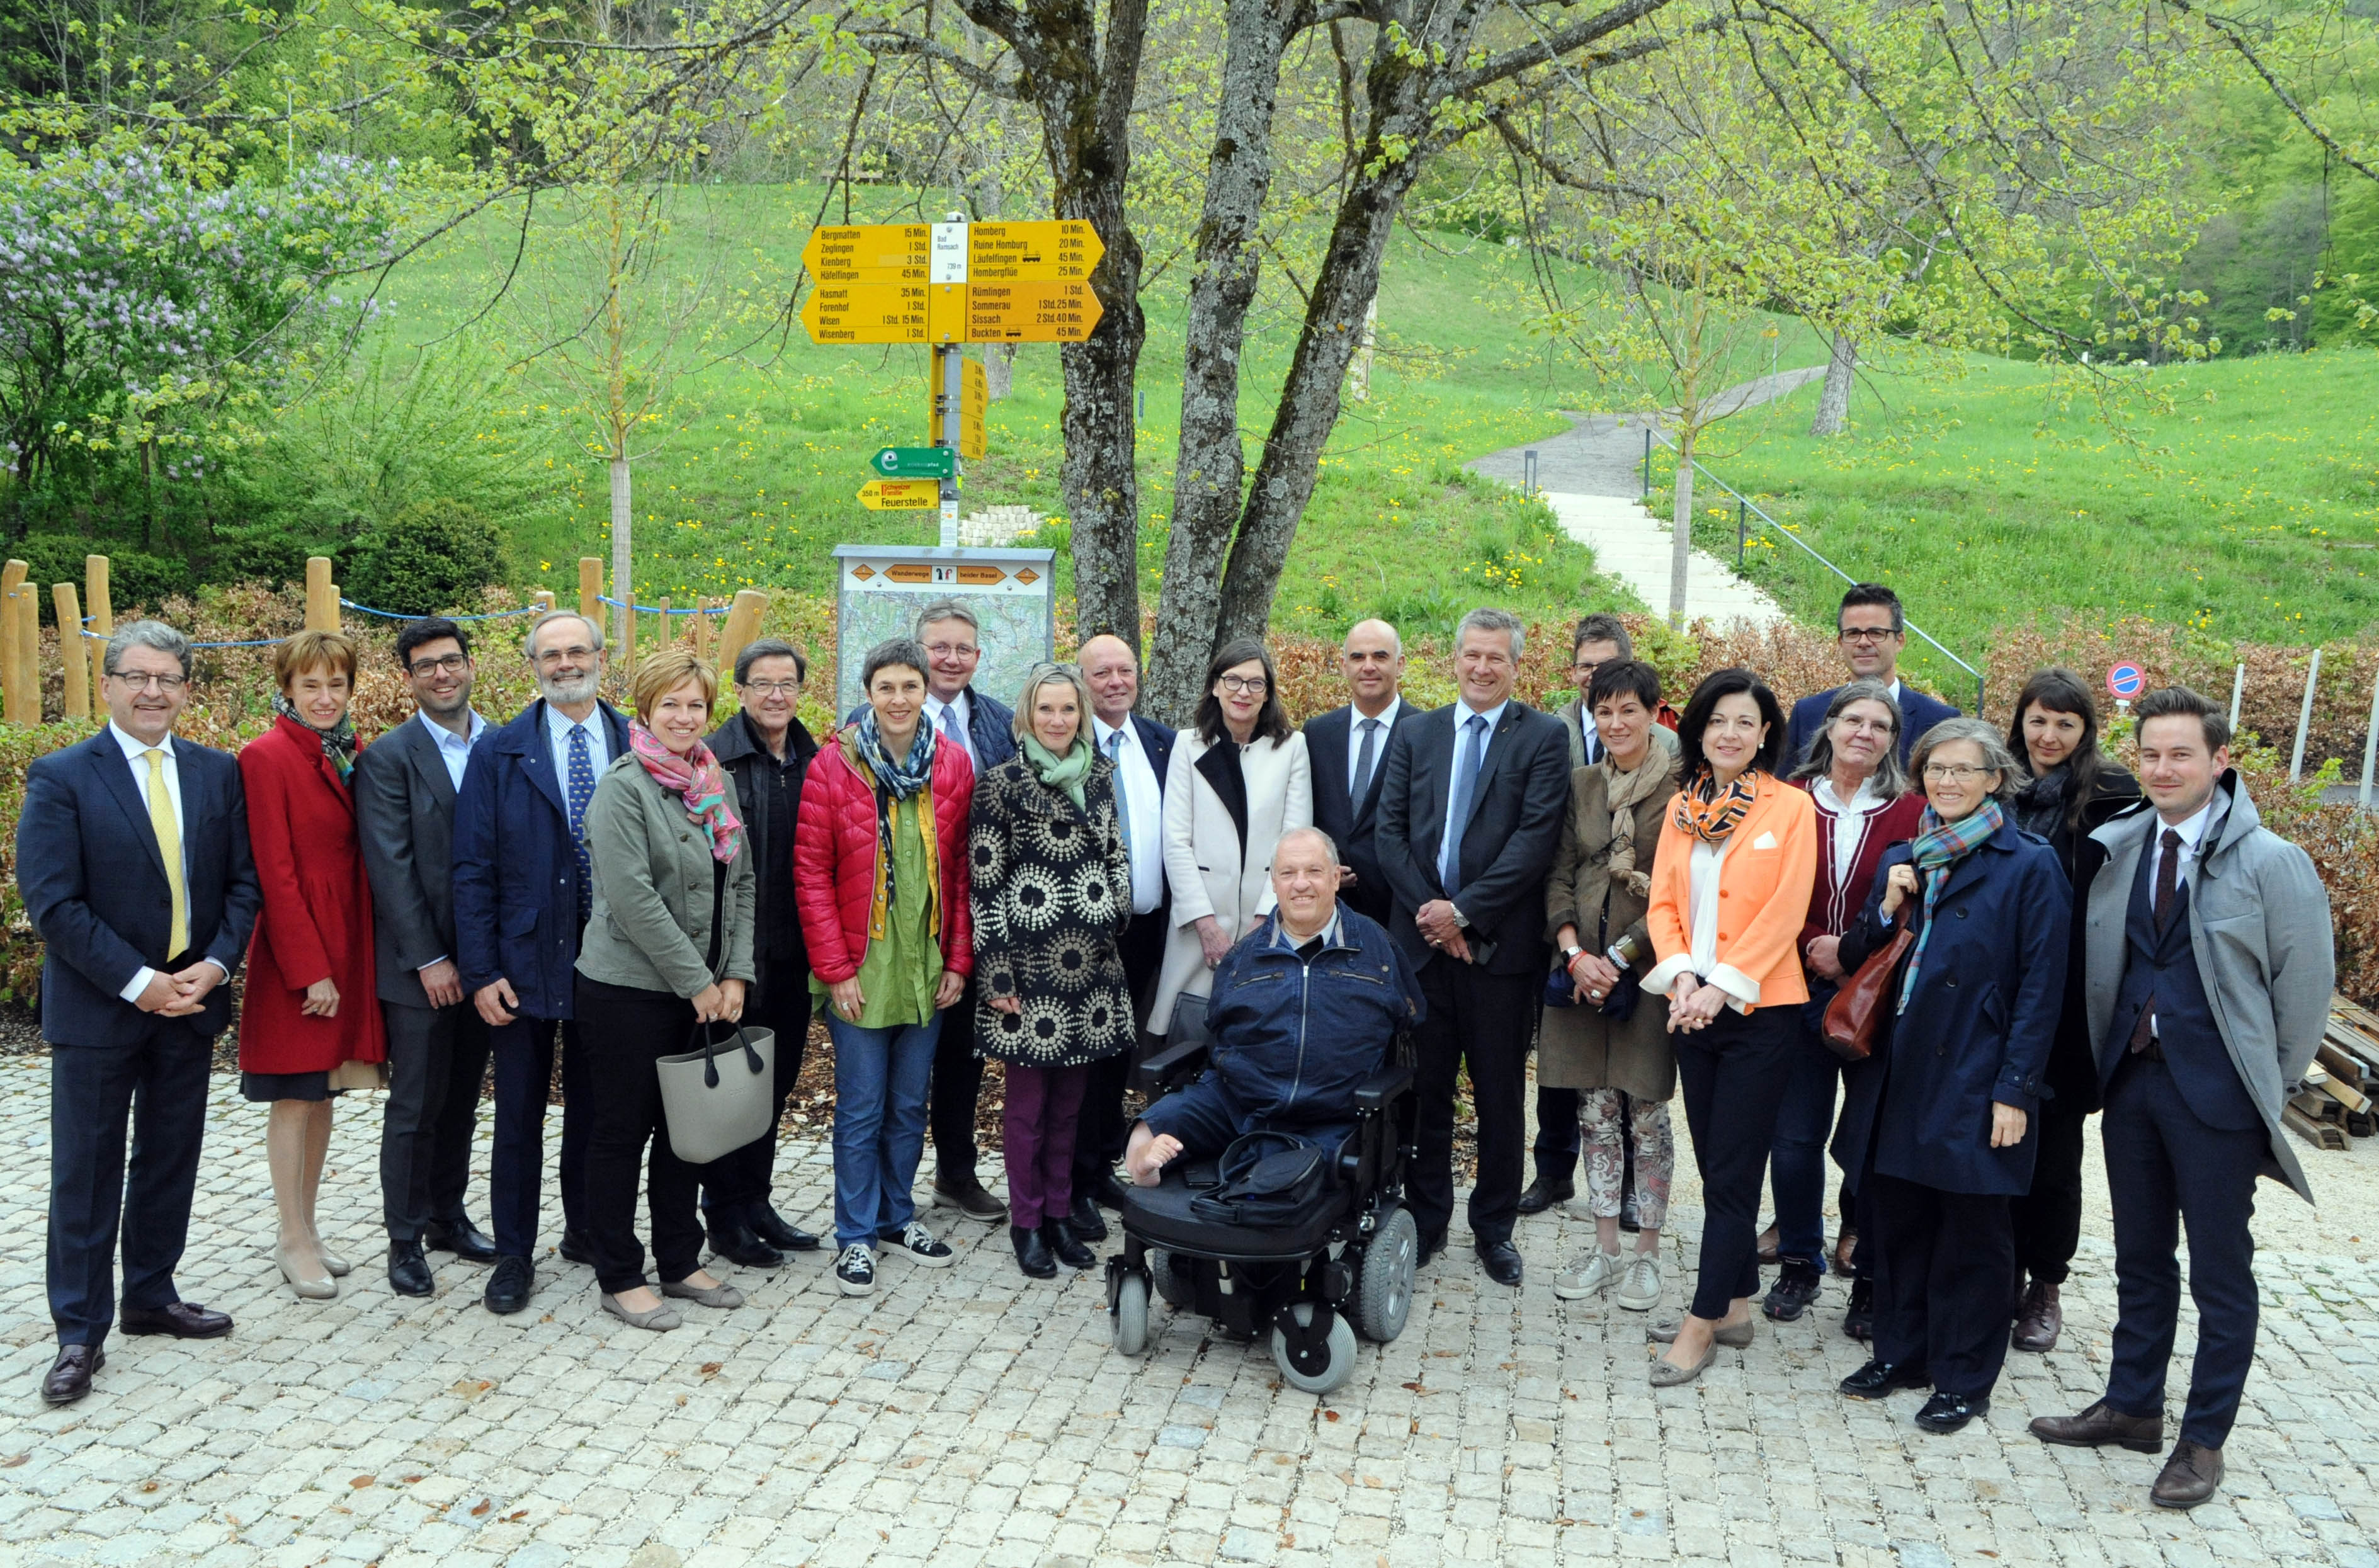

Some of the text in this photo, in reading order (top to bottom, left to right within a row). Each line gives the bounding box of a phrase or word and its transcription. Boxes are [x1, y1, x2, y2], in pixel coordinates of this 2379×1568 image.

[905, 228, 927, 237] 15 Min.
[974, 227, 1006, 236] Homberg
[1062, 224, 1085, 234] 10 Min.
[821, 230, 860, 241] Bergmatten
[909, 242, 927, 251] 1 Std.
[974, 240, 1028, 250] Ruine Homburg
[1059, 239, 1084, 247] 20 Min.
[821, 244, 854, 254] Zeglingen
[907, 255, 927, 264] 3 Std.
[974, 254, 1017, 265] Läufelfingen
[1059, 253, 1084, 262] 45 Min.
[820, 258, 851, 267] Kienberg
[902, 269, 926, 278] 45 Min.
[974, 268, 1018, 278] Hombergflüe
[1059, 266, 1084, 276] 25 Min.
[820, 271, 859, 281] Häfelfingen
[820, 290, 848, 298] Hasmatt
[901, 288, 926, 297] 35 Min.
[972, 287, 1011, 297] Rümlingen
[1065, 285, 1083, 295] 1 Std.
[820, 302, 849, 312] Forenhof
[908, 302, 925, 310] 1 Std.
[972, 301, 1011, 310] Sommerau
[1039, 300, 1083, 309] 1 Std. 25 Min.
[819, 316, 839, 325] Wisen
[887, 315, 899, 324] Std.
[902, 315, 909, 324] 15
[911, 315, 925, 324] Min.
[972, 315, 1001, 324] Sissach
[1037, 314, 1083, 323] 2 Std. 40 Min.
[819, 329, 855, 339] Wisenberg
[907, 329, 924, 338] 1 Std.
[972, 329, 1001, 337] Buckten
[1057, 327, 1082, 336] 45 Min.
[882, 497, 928, 507] Feuerstelle
